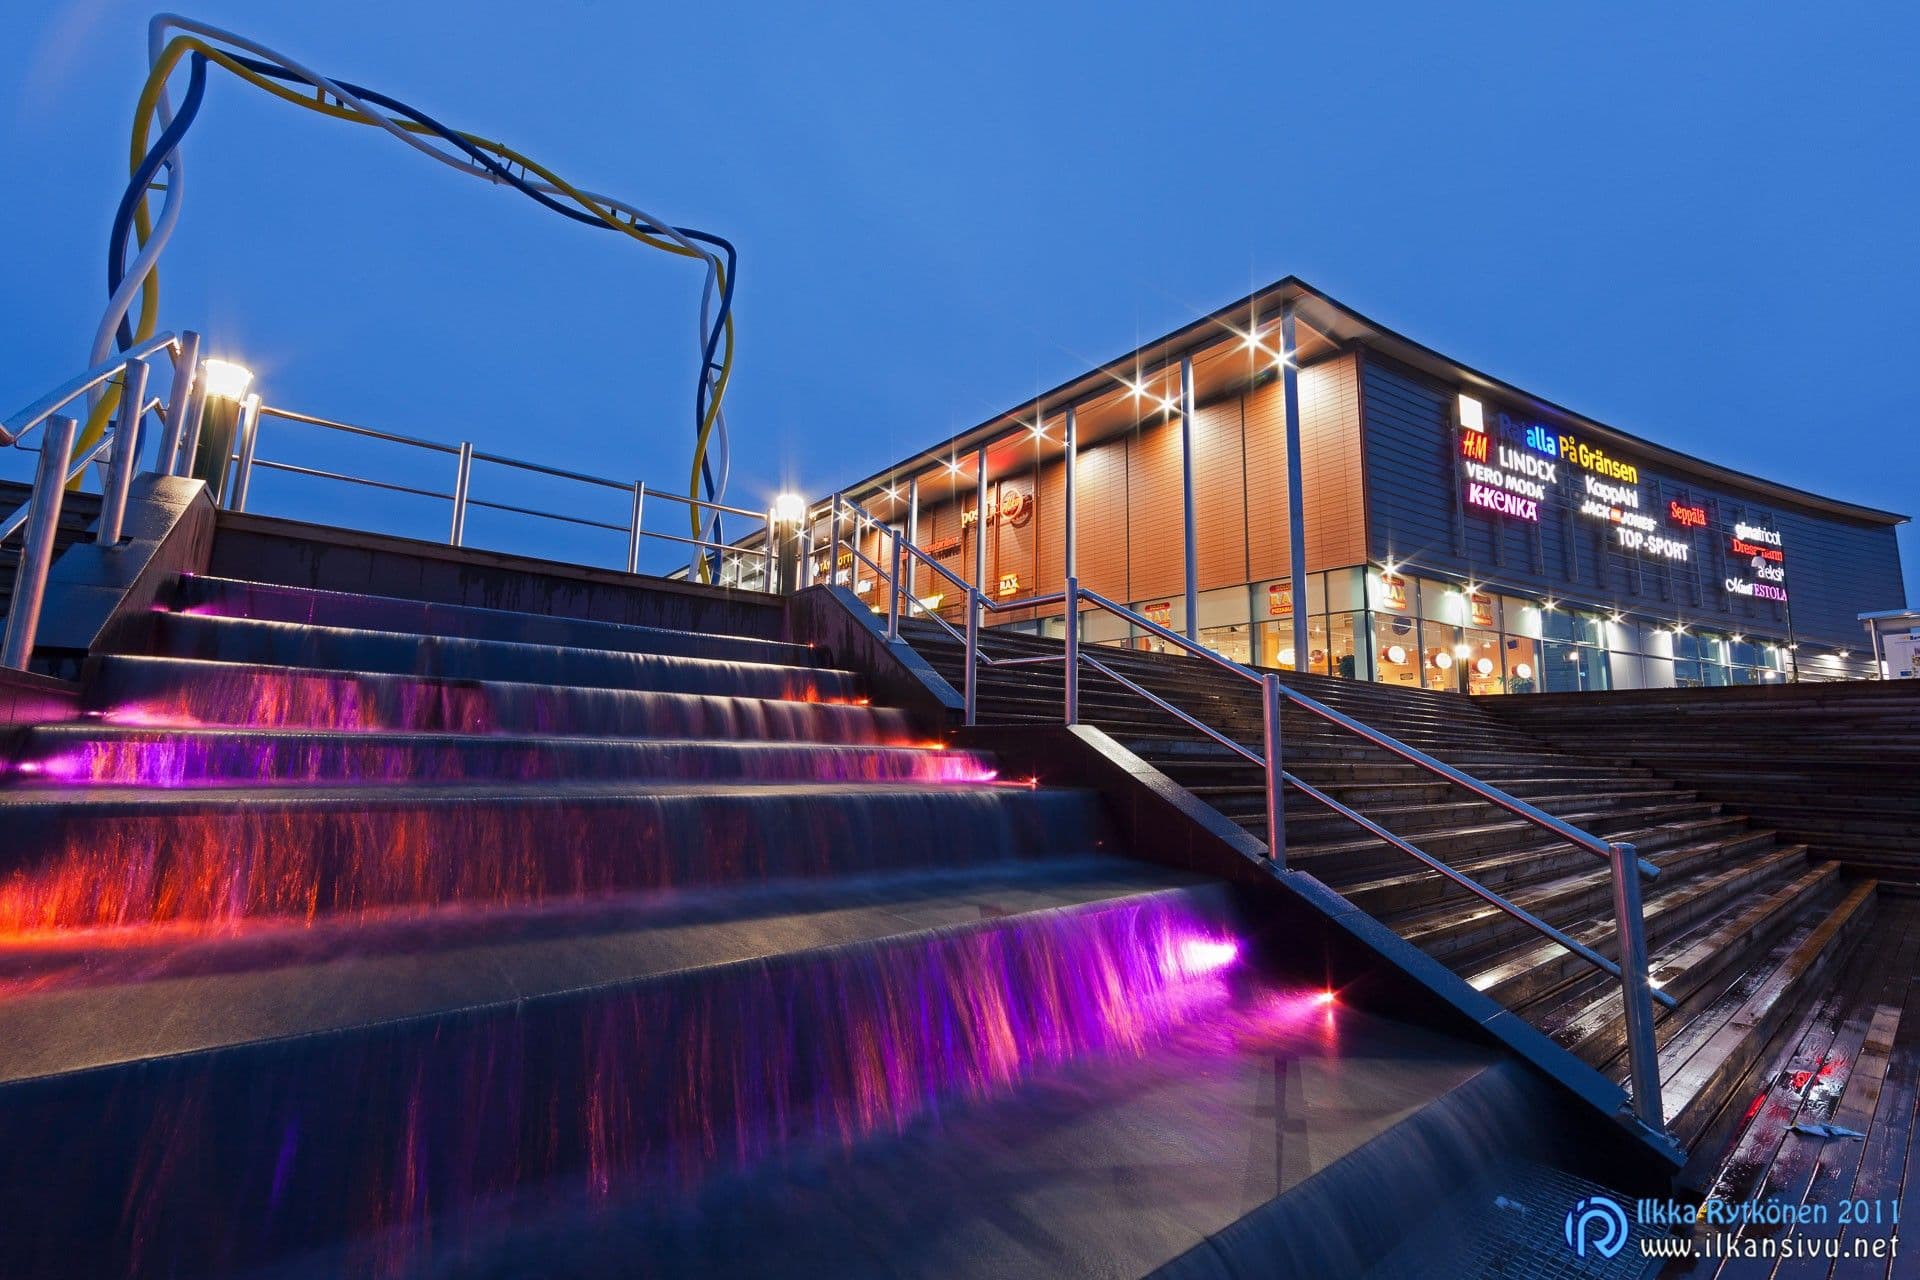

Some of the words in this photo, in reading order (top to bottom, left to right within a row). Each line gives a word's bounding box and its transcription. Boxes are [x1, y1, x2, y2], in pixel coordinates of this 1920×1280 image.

[1463, 430, 1488, 463] H&M
[1559, 435, 1578, 465] På
[1578, 443, 1638, 484] Gränsen
[1498, 445, 1557, 484] LINDEX
[1465, 461, 1504, 487] VERO
[1505, 474, 1545, 501] MODA
[1581, 500, 1610, 520] JACK
[1671, 501, 1706, 527] Seppälä
[1270, 592, 1292, 605] RA
[1754, 584, 1788, 602] ESTOLA
